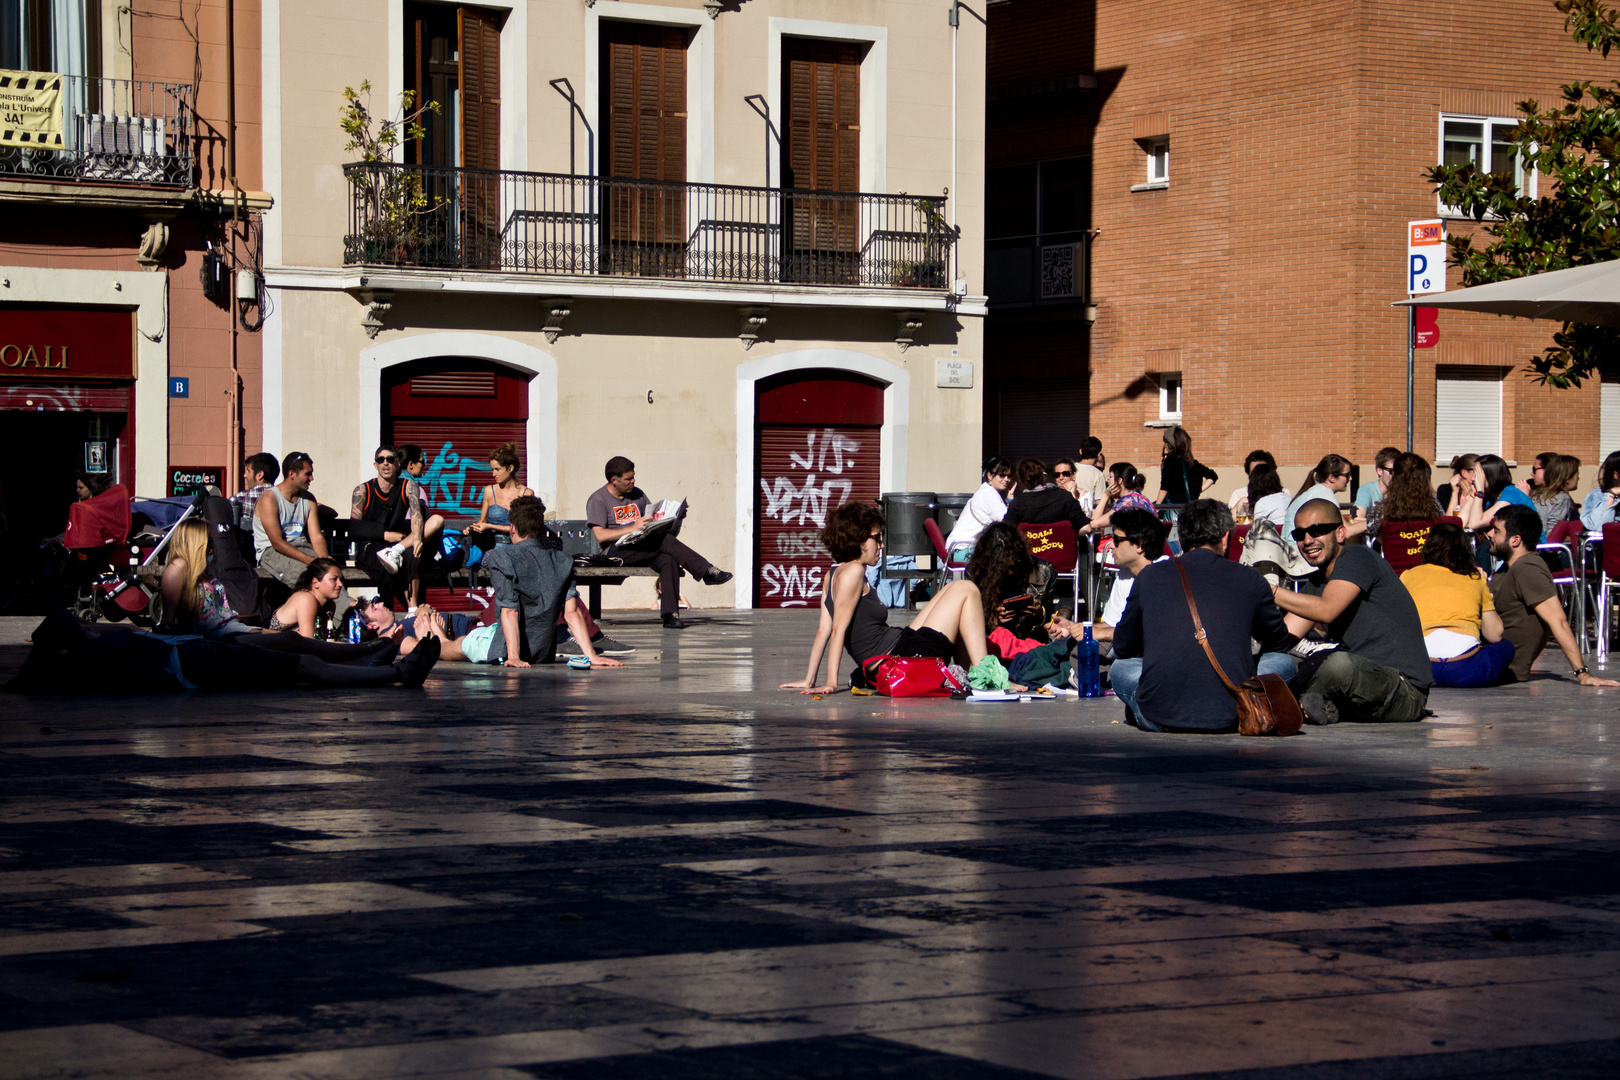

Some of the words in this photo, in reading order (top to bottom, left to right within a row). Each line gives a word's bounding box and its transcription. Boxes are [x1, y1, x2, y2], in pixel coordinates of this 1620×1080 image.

[12, 103, 52, 113] L'Univers
[4, 113, 24, 125] JA!
[1410, 254, 1427, 290] P
[175, 382, 184, 393] B
[174, 470, 216, 484] Cocteles
